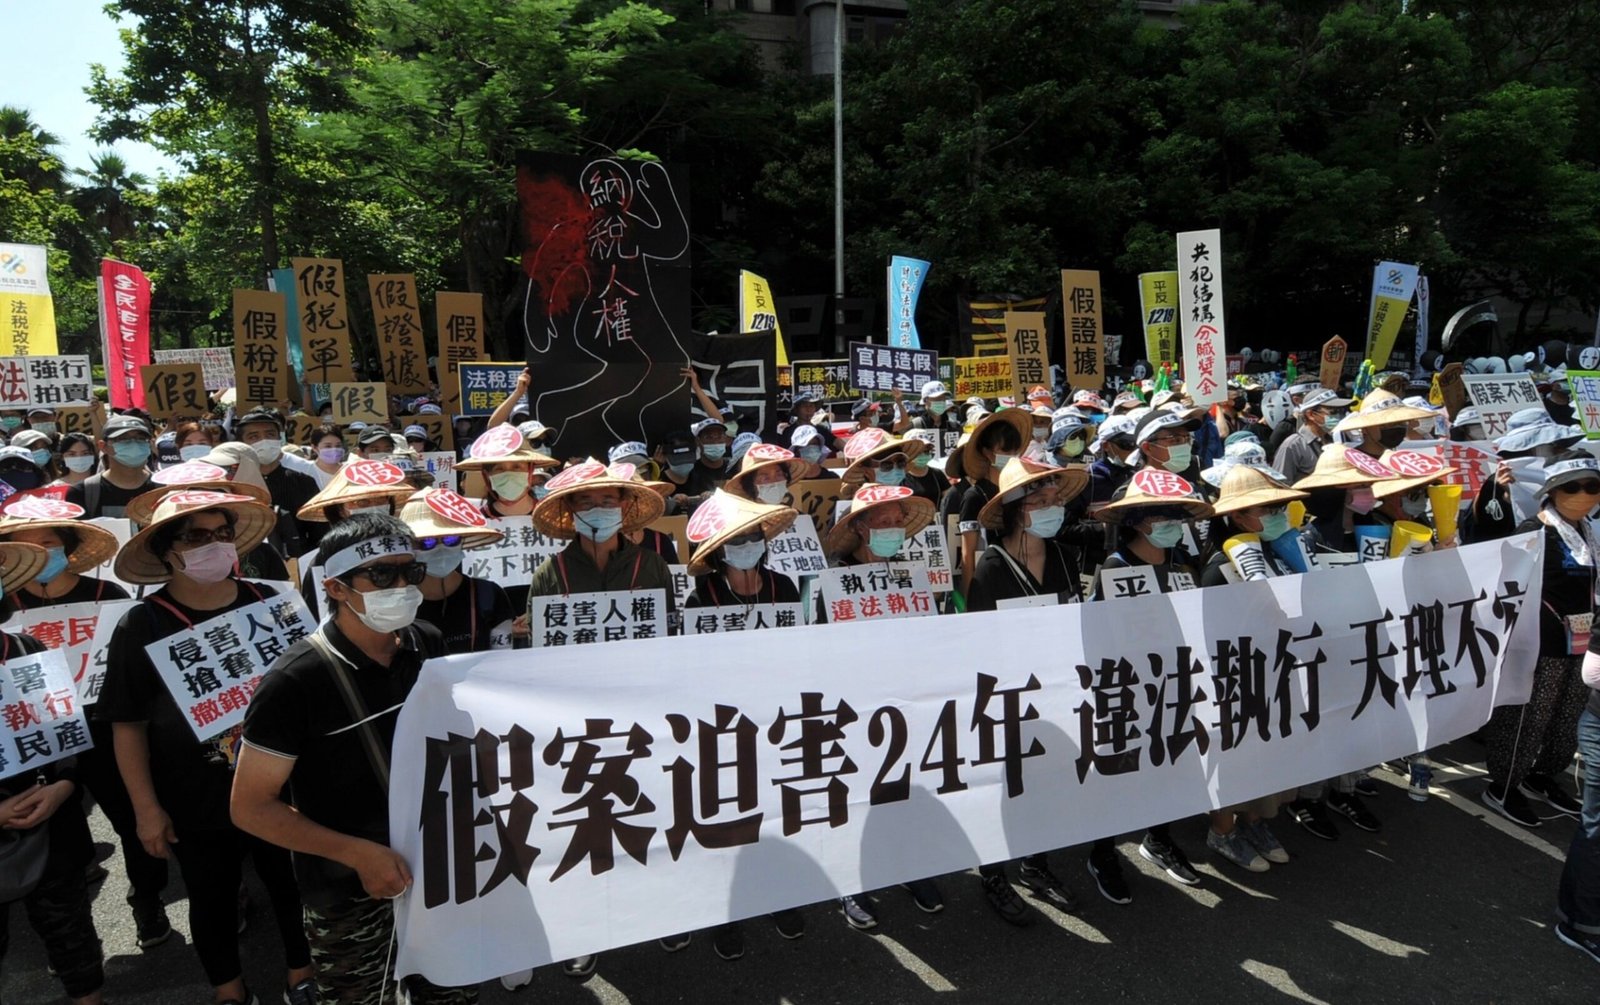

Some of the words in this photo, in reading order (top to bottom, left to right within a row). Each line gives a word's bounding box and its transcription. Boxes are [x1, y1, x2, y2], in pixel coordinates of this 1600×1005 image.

[587, 170, 640, 347] 納稅人權
[1153, 280, 1168, 304] 平反
[299, 264, 346, 382] 假稅單
[1147, 308, 1175, 325] 1219
[374, 280, 426, 388] 假證據
[1069, 287, 1099, 376] 假證據
[30, 360, 86, 379] 強行
[242, 309, 279, 404] 假稅單
[857, 347, 931, 372] 官員造假
[34, 384, 90, 404] 拍賣
[148, 370, 197, 412] 假
[798, 383, 860, 399] 稅沒人
[857, 369, 931, 393] 毒害全國
[1470, 380, 1540, 406] 假案不撤
[334, 386, 385, 418] 假
[346, 461, 404, 485] 假
[1390, 451, 1443, 476] 假
[1134, 470, 1192, 497] 假
[426, 489, 486, 526] 假
[770, 536, 819, 554] 沒良心
[899, 530, 941, 550] 人權
[770, 555, 826, 571] 下地獄
[840, 568, 913, 595] 執行署
[1113, 576, 1150, 597] 平
[543, 598, 656, 628] 侵害人權
[831, 591, 931, 622] 違法執行
[168, 601, 302, 672] 侵害人權
[1, 688, 73, 732] 執行
[418, 671, 1046, 910] 假案迫害24年
[1072, 621, 1327, 785] 違法執行
